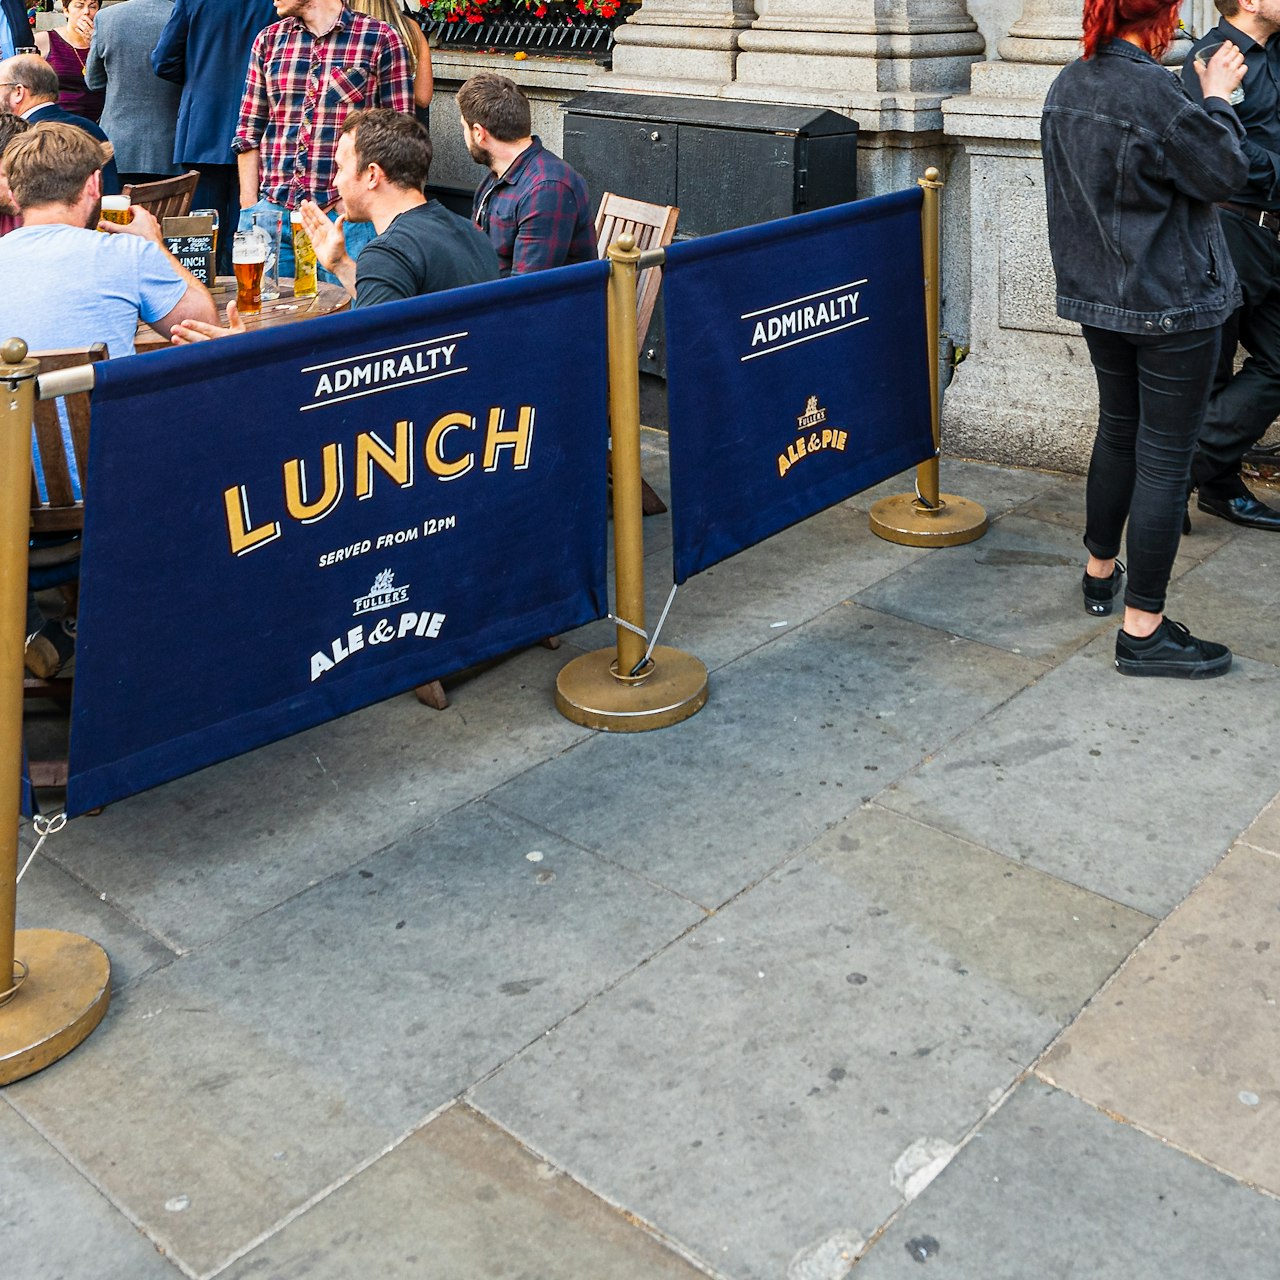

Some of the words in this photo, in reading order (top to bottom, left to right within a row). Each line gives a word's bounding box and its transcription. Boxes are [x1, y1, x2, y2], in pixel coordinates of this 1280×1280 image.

[180, 257, 205, 267] UNCH
[751, 291, 860, 346] ADMIRALTY
[314, 344, 457, 397] ADMIRALTY
[224, 406, 536, 557] LUNCH
[318, 540, 371, 567] SERVED
[376, 528, 418, 549] FROM
[423, 515, 456, 537] 12PM
